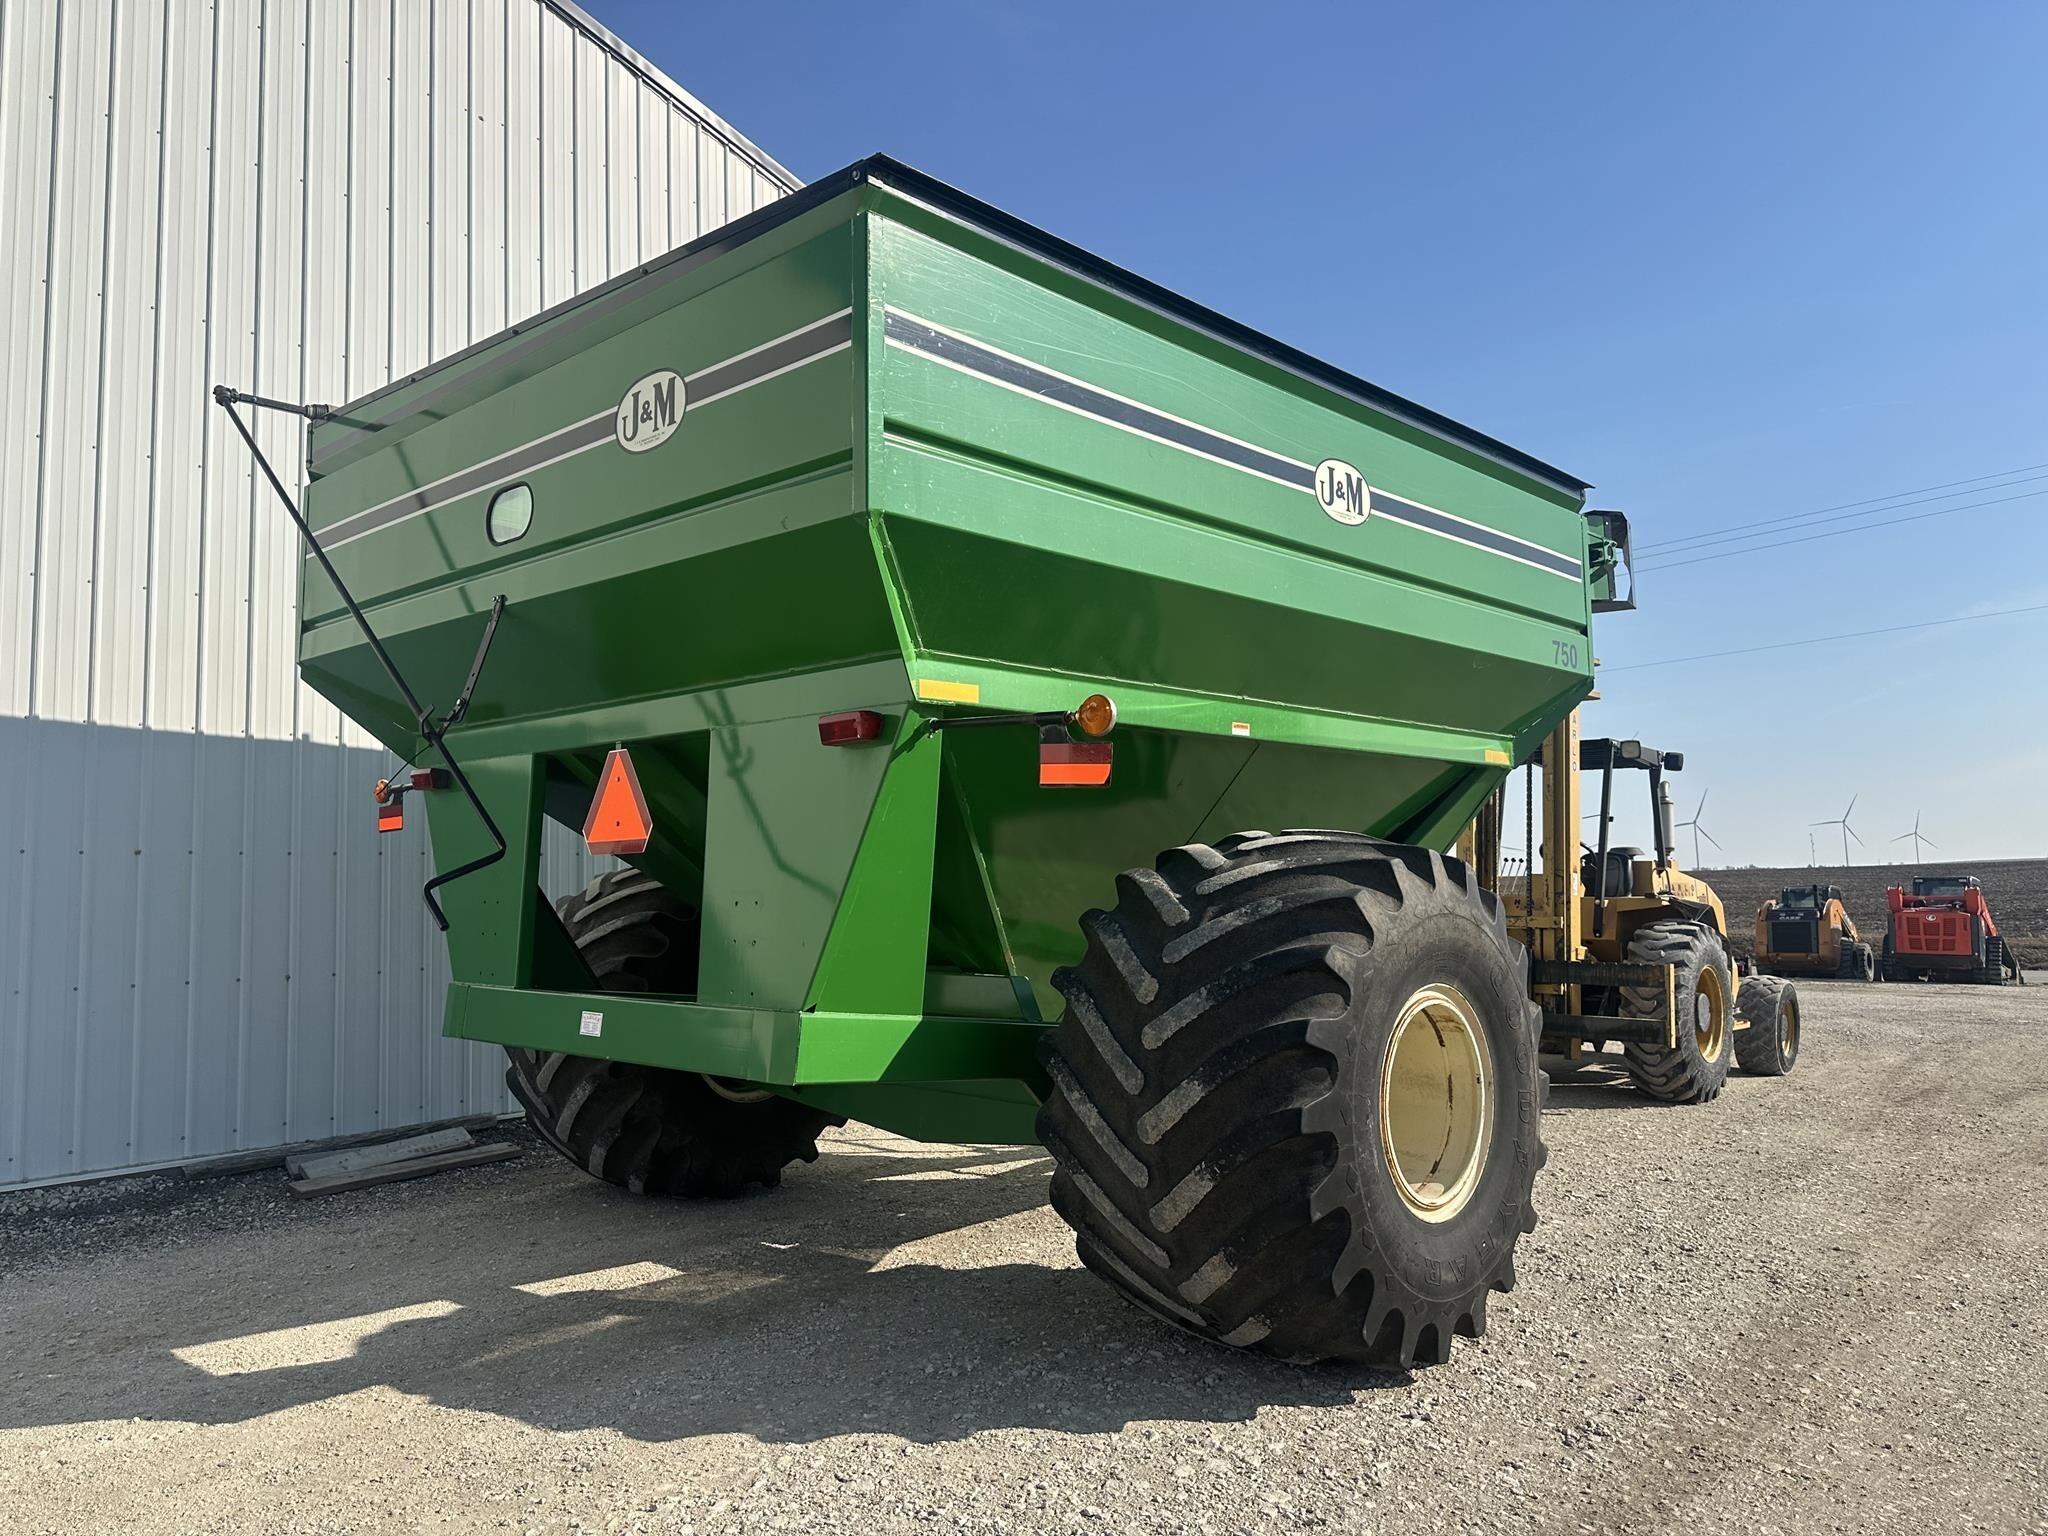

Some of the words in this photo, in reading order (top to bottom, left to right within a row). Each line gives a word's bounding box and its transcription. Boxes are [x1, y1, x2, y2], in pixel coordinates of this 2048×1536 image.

[622, 376, 677, 442] J&M
[1320, 466, 1364, 516] J&M
[1552, 640, 1577, 669] 750
